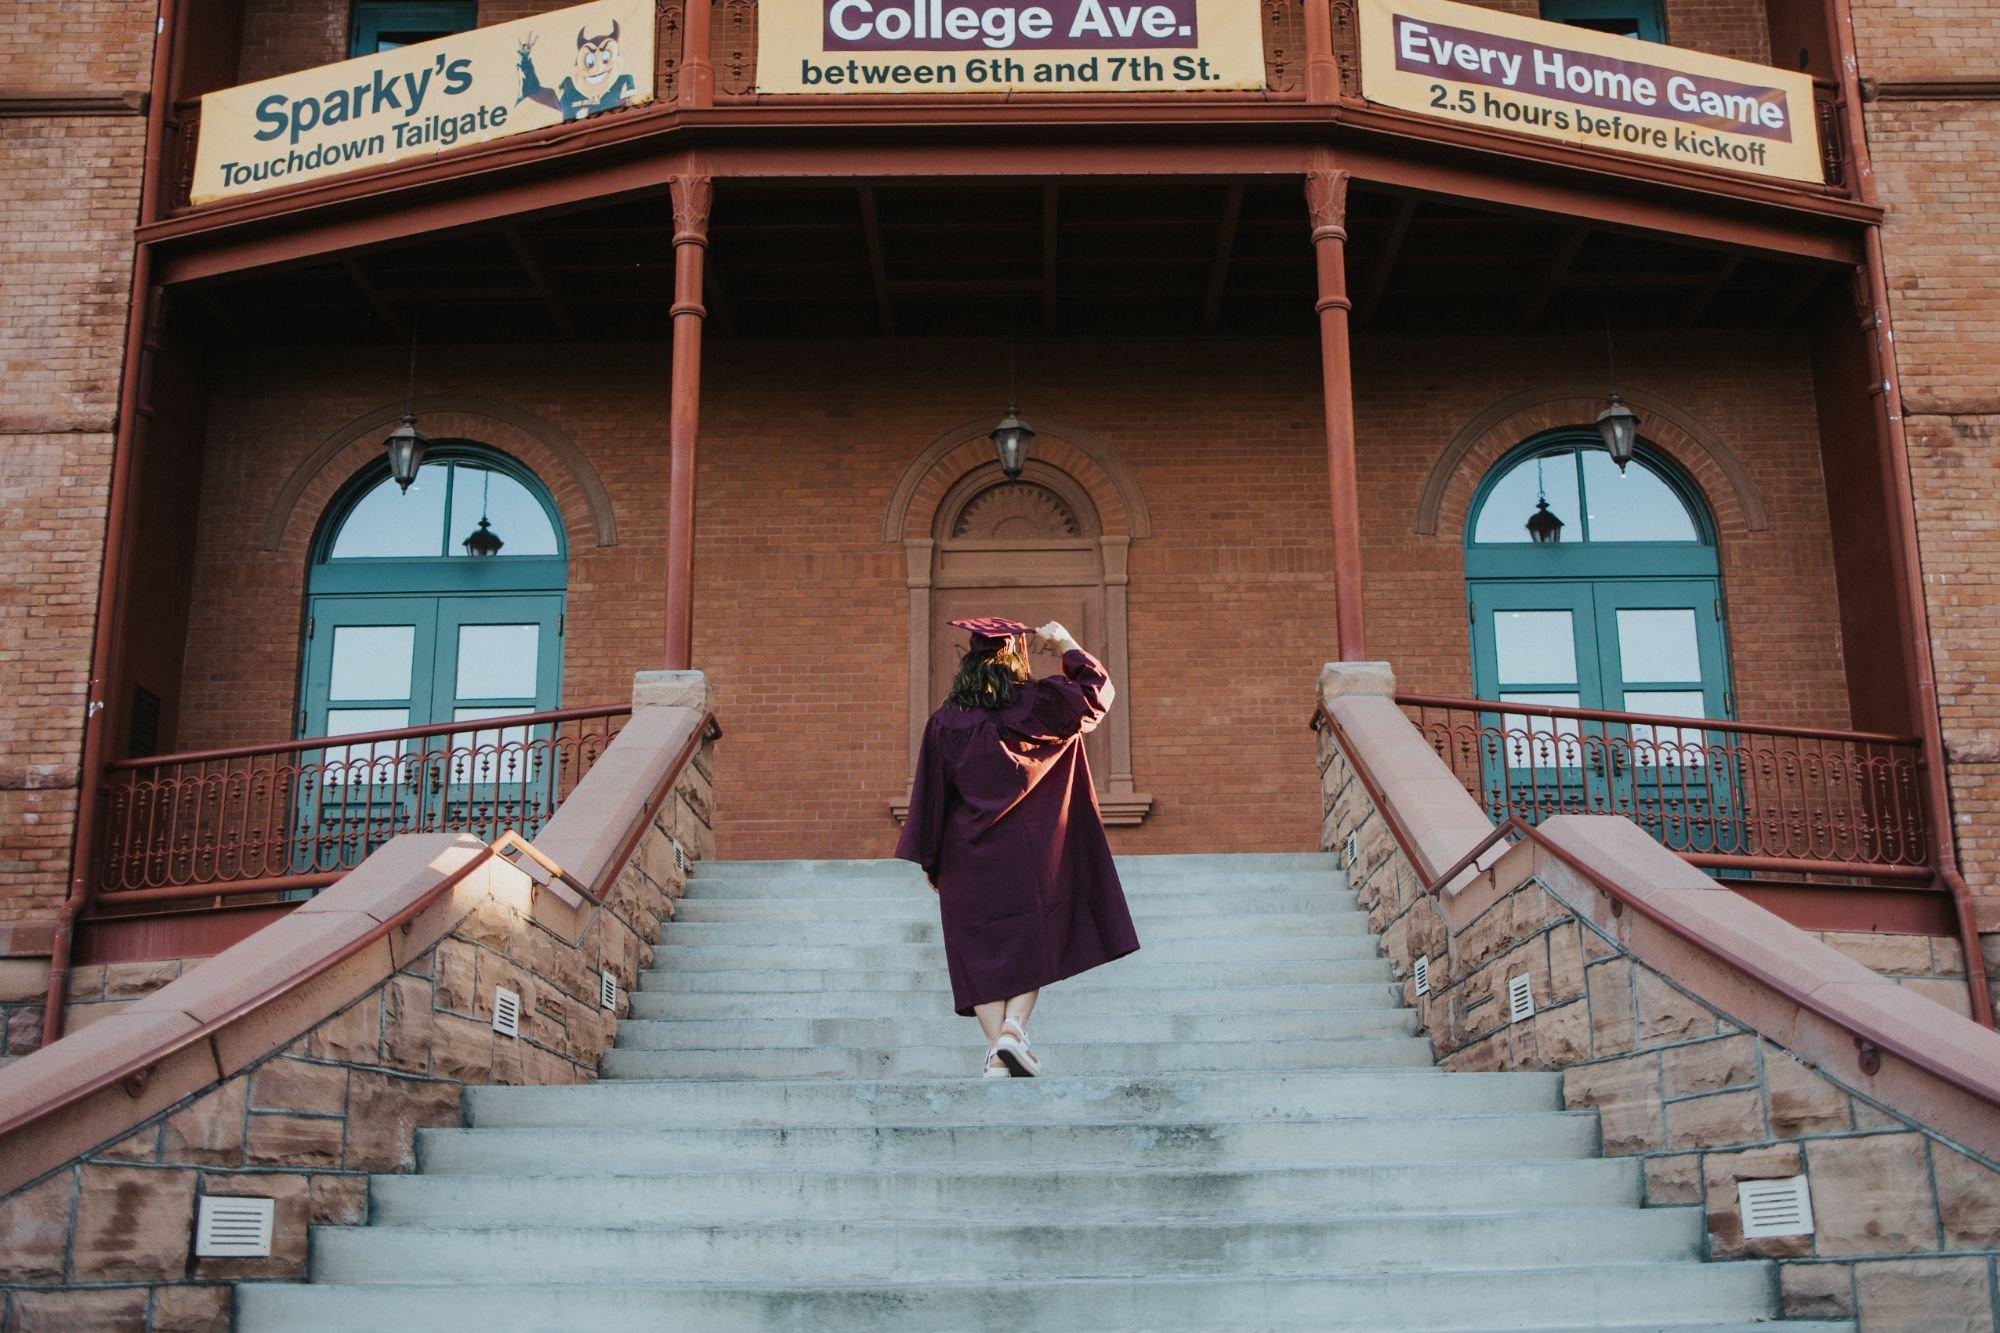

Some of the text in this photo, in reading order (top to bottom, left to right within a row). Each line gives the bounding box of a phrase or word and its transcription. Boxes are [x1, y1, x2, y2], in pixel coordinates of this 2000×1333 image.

[829, 0, 1192, 48] College Ave.
[254, 53, 472, 144] Sparky's
[802, 56, 1220, 85] between 6th and 7th St.
[1400, 21, 1784, 128] Every Home Game
[221, 105, 507, 187] Touchdown Tailgate
[1430, 84, 1766, 166] 2.5 hours before kickoff
